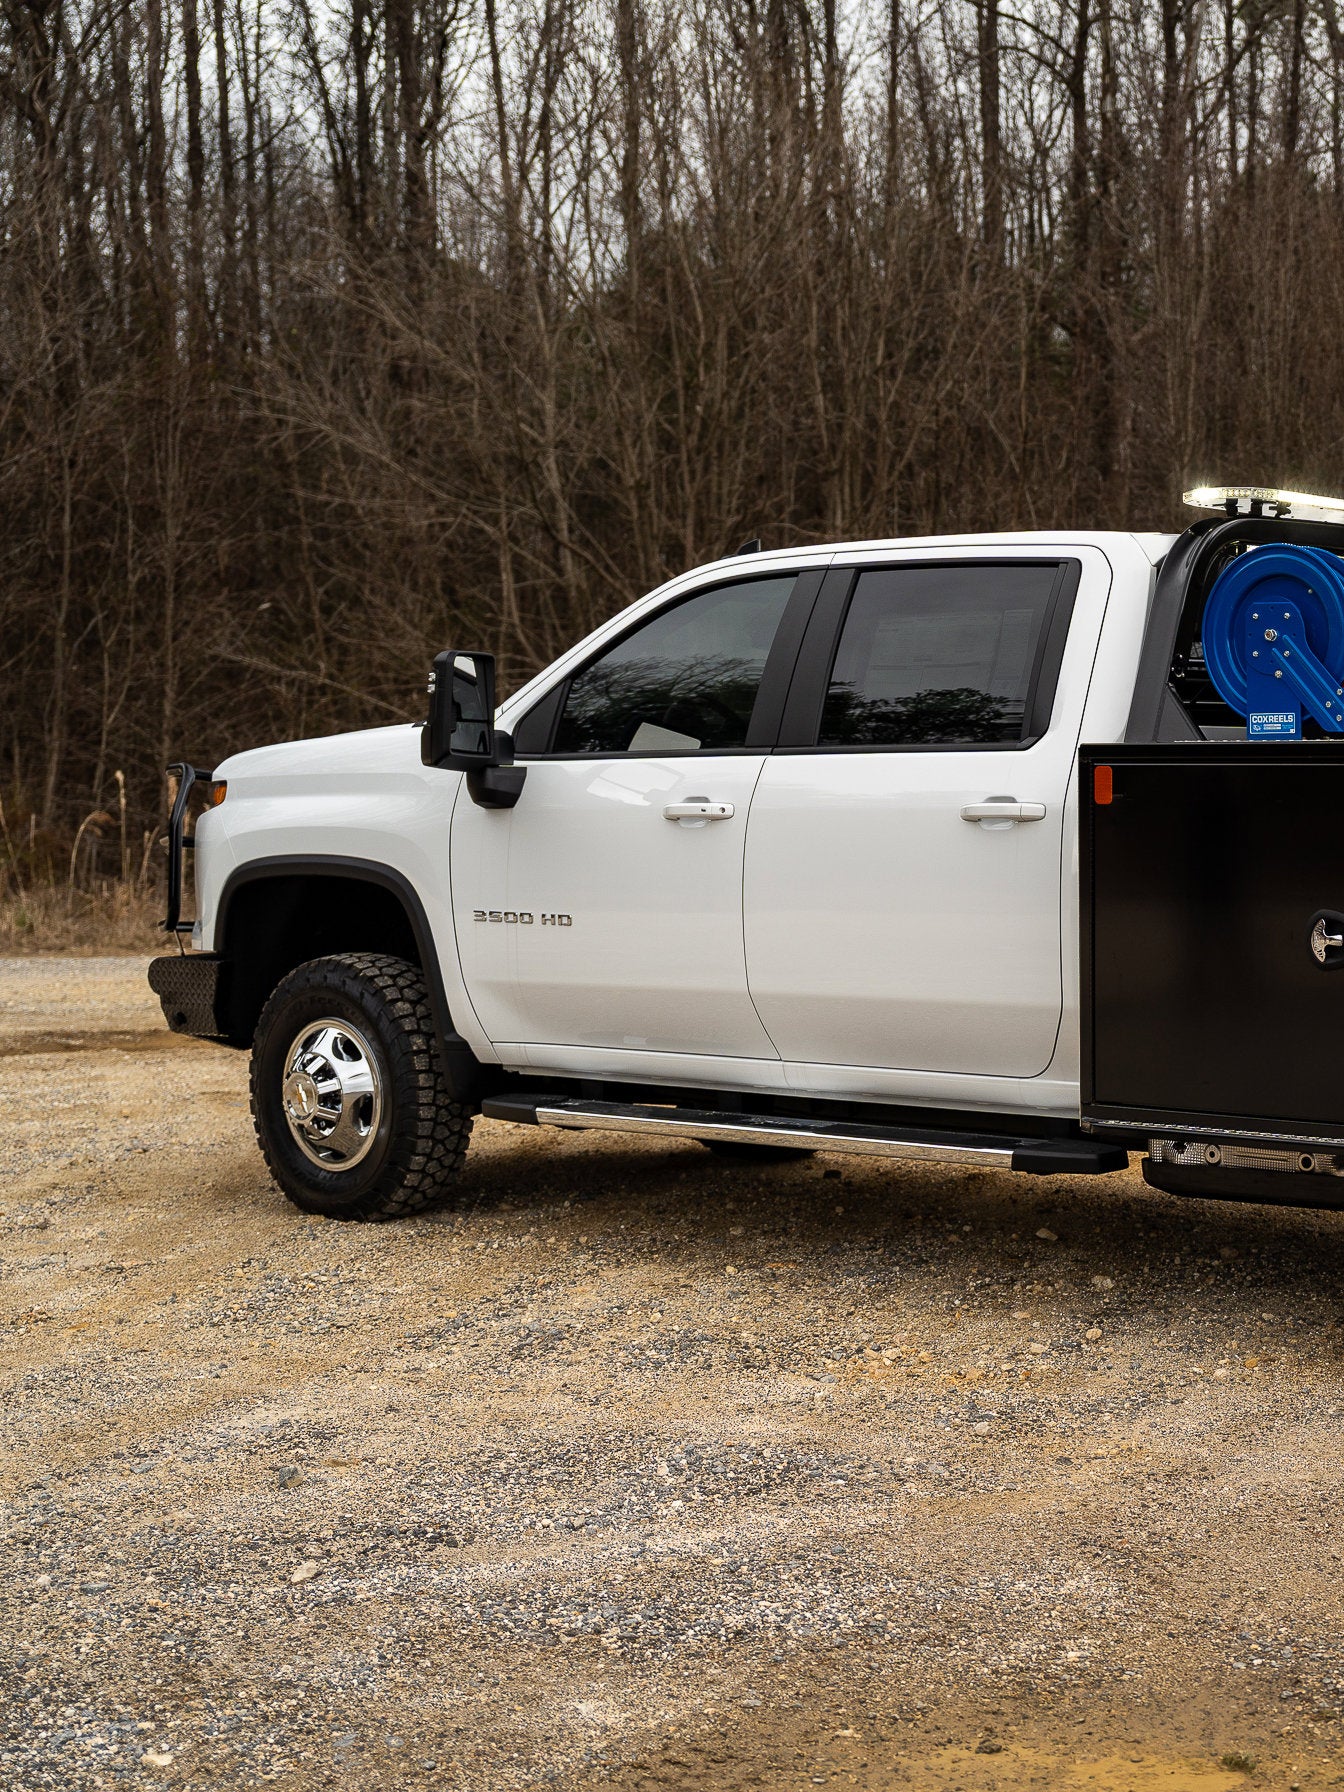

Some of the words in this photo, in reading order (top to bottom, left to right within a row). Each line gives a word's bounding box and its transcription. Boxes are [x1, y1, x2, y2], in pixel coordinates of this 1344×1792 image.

[1251, 714, 1294, 723] COXREELS
[473, 910, 534, 924] 3500
[541, 913, 572, 926] HD
